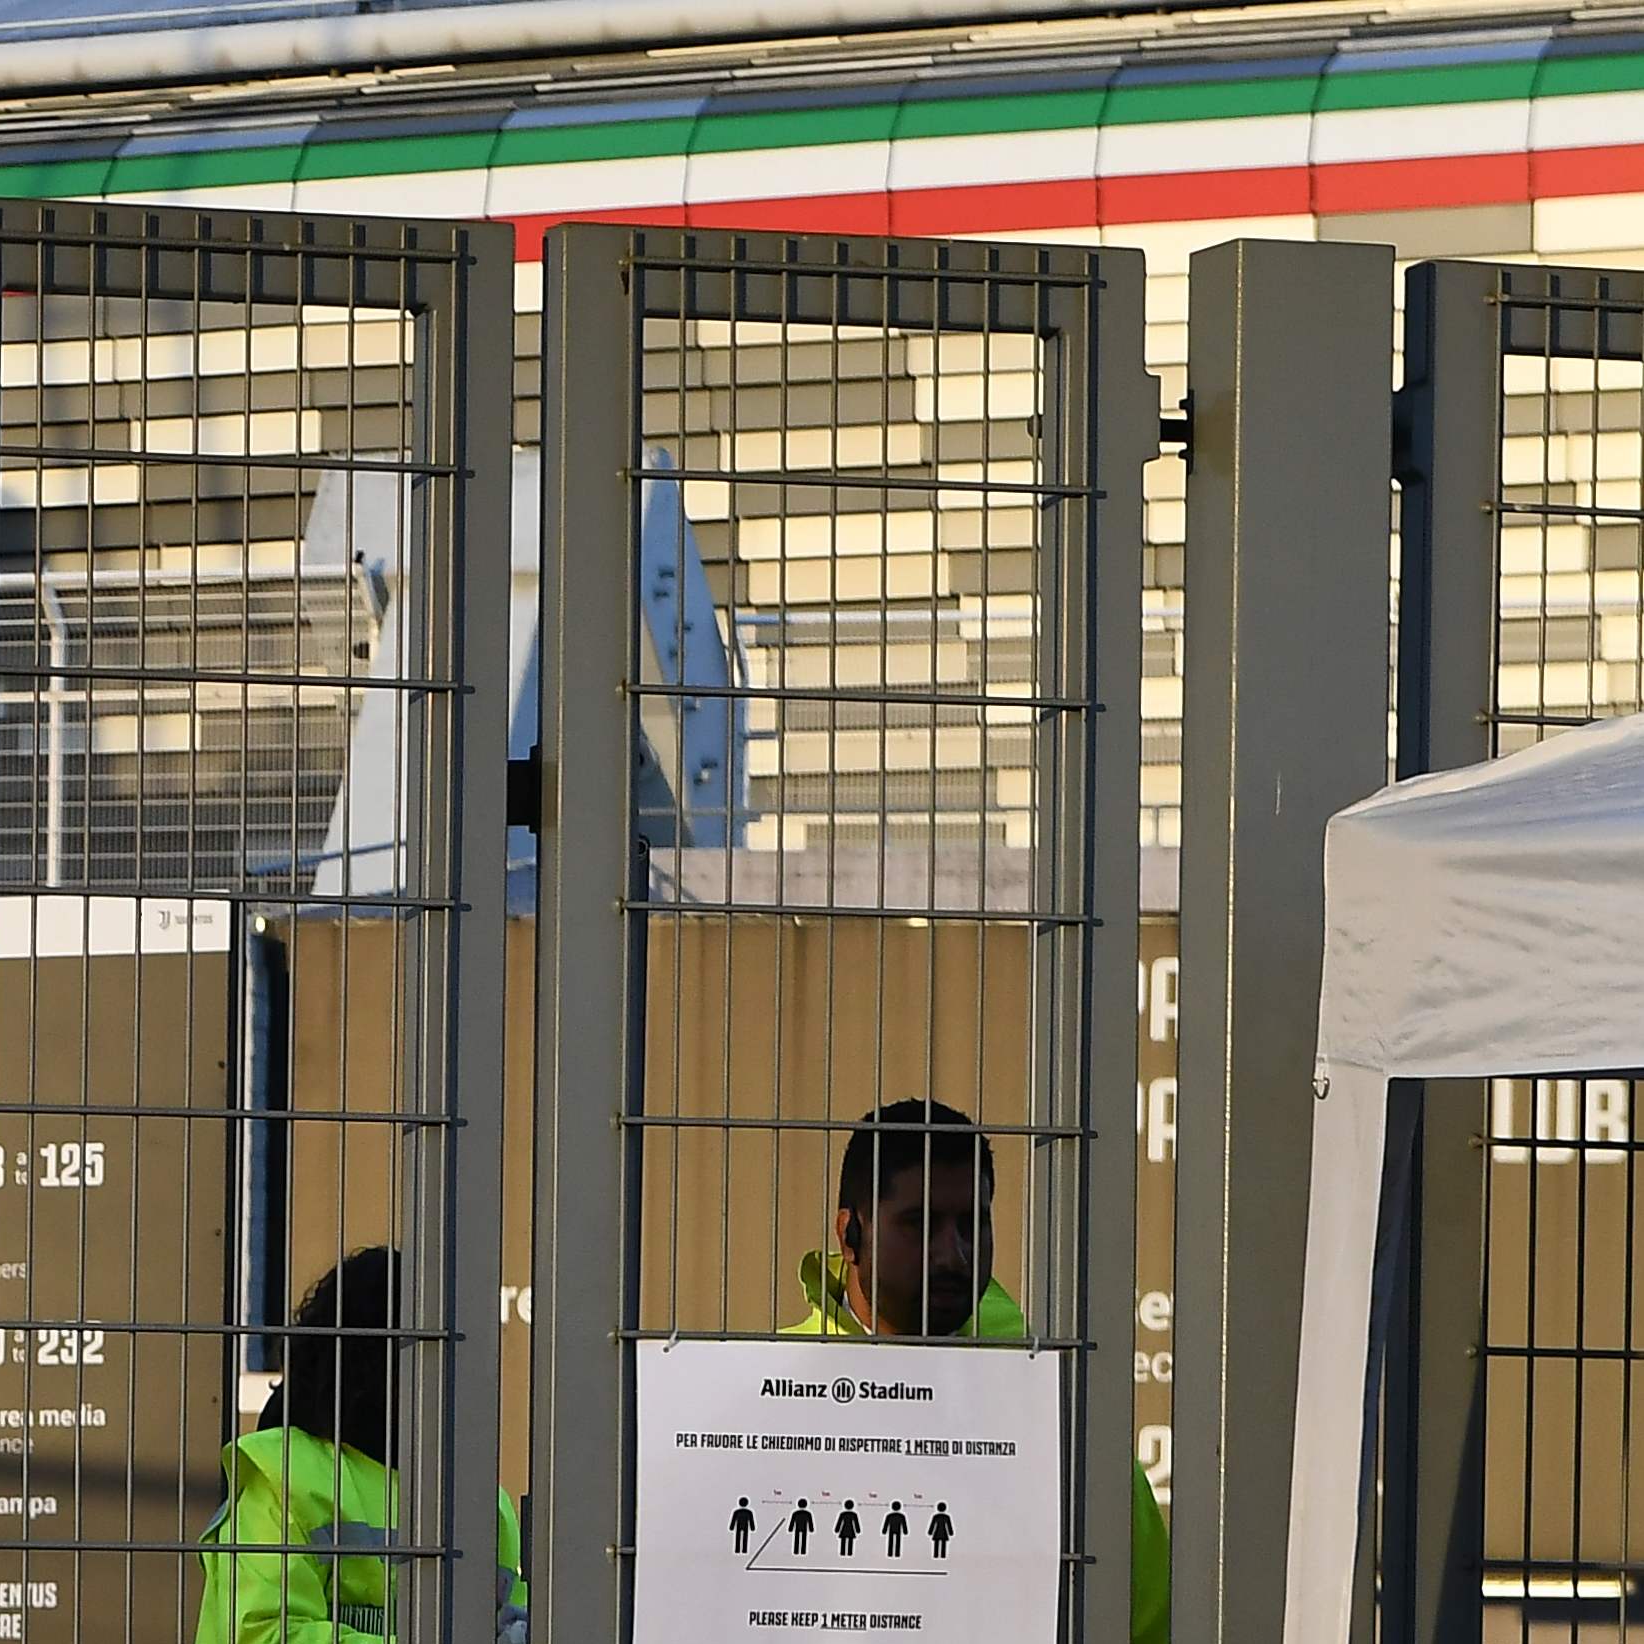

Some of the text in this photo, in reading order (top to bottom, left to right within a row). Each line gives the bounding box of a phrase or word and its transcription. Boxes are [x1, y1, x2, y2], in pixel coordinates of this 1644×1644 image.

[39, 1141, 105, 1187] 125
[37, 1319, 105, 1366] 232
[760, 1378, 934, 1401] Allianz Stadium
[39, 1402, 106, 1428] media
[676, 1433, 698, 1448] PER
[701, 1434, 743, 1449] FAVORE
[746, 1435, 759, 1450] LE
[761, 1435, 822, 1451] CHIEDIAMO
[825, 1437, 836, 1452] DI
[838, 1438, 902, 1453] RISPETTARE
[914, 1440, 949, 1455] METRO
[952, 1441, 962, 1455] DI
[965, 1441, 1016, 1456] DISTANZA
[749, 1611, 789, 1627] PLEASE
[791, 1612, 819, 1627] KEEP
[830, 1613, 867, 1629] METER
[869, 1614, 922, 1630] DISTANCE
